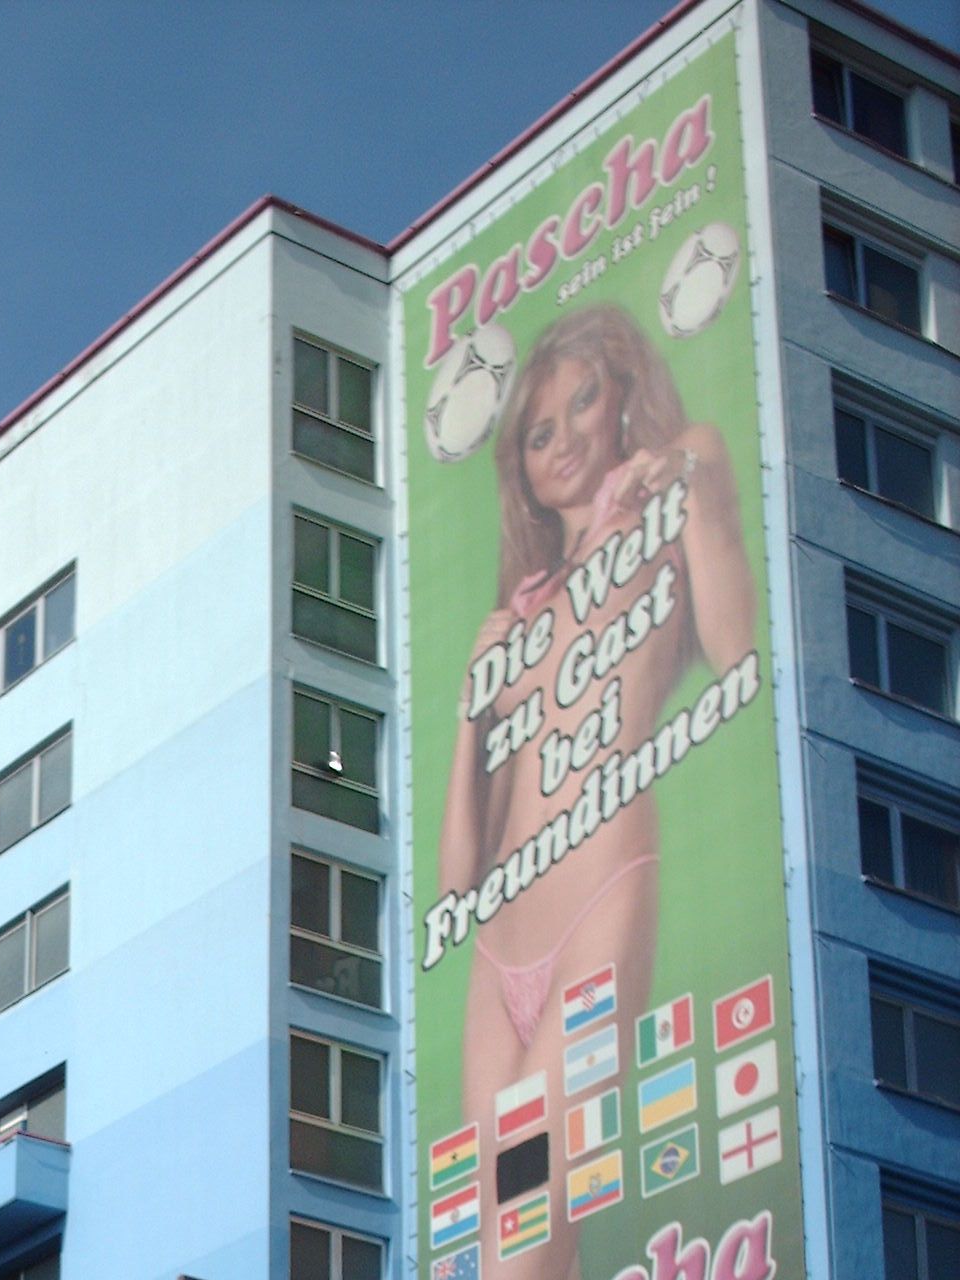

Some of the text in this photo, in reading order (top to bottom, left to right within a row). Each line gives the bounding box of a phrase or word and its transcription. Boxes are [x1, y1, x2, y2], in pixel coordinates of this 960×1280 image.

[427, 95, 713, 366] Pascha
[467, 477, 689, 721] Die Welt
[485, 560, 677, 774] zu Gast
[421, 650, 761, 972] Freundinnen
[539, 676, 623, 797] bei
